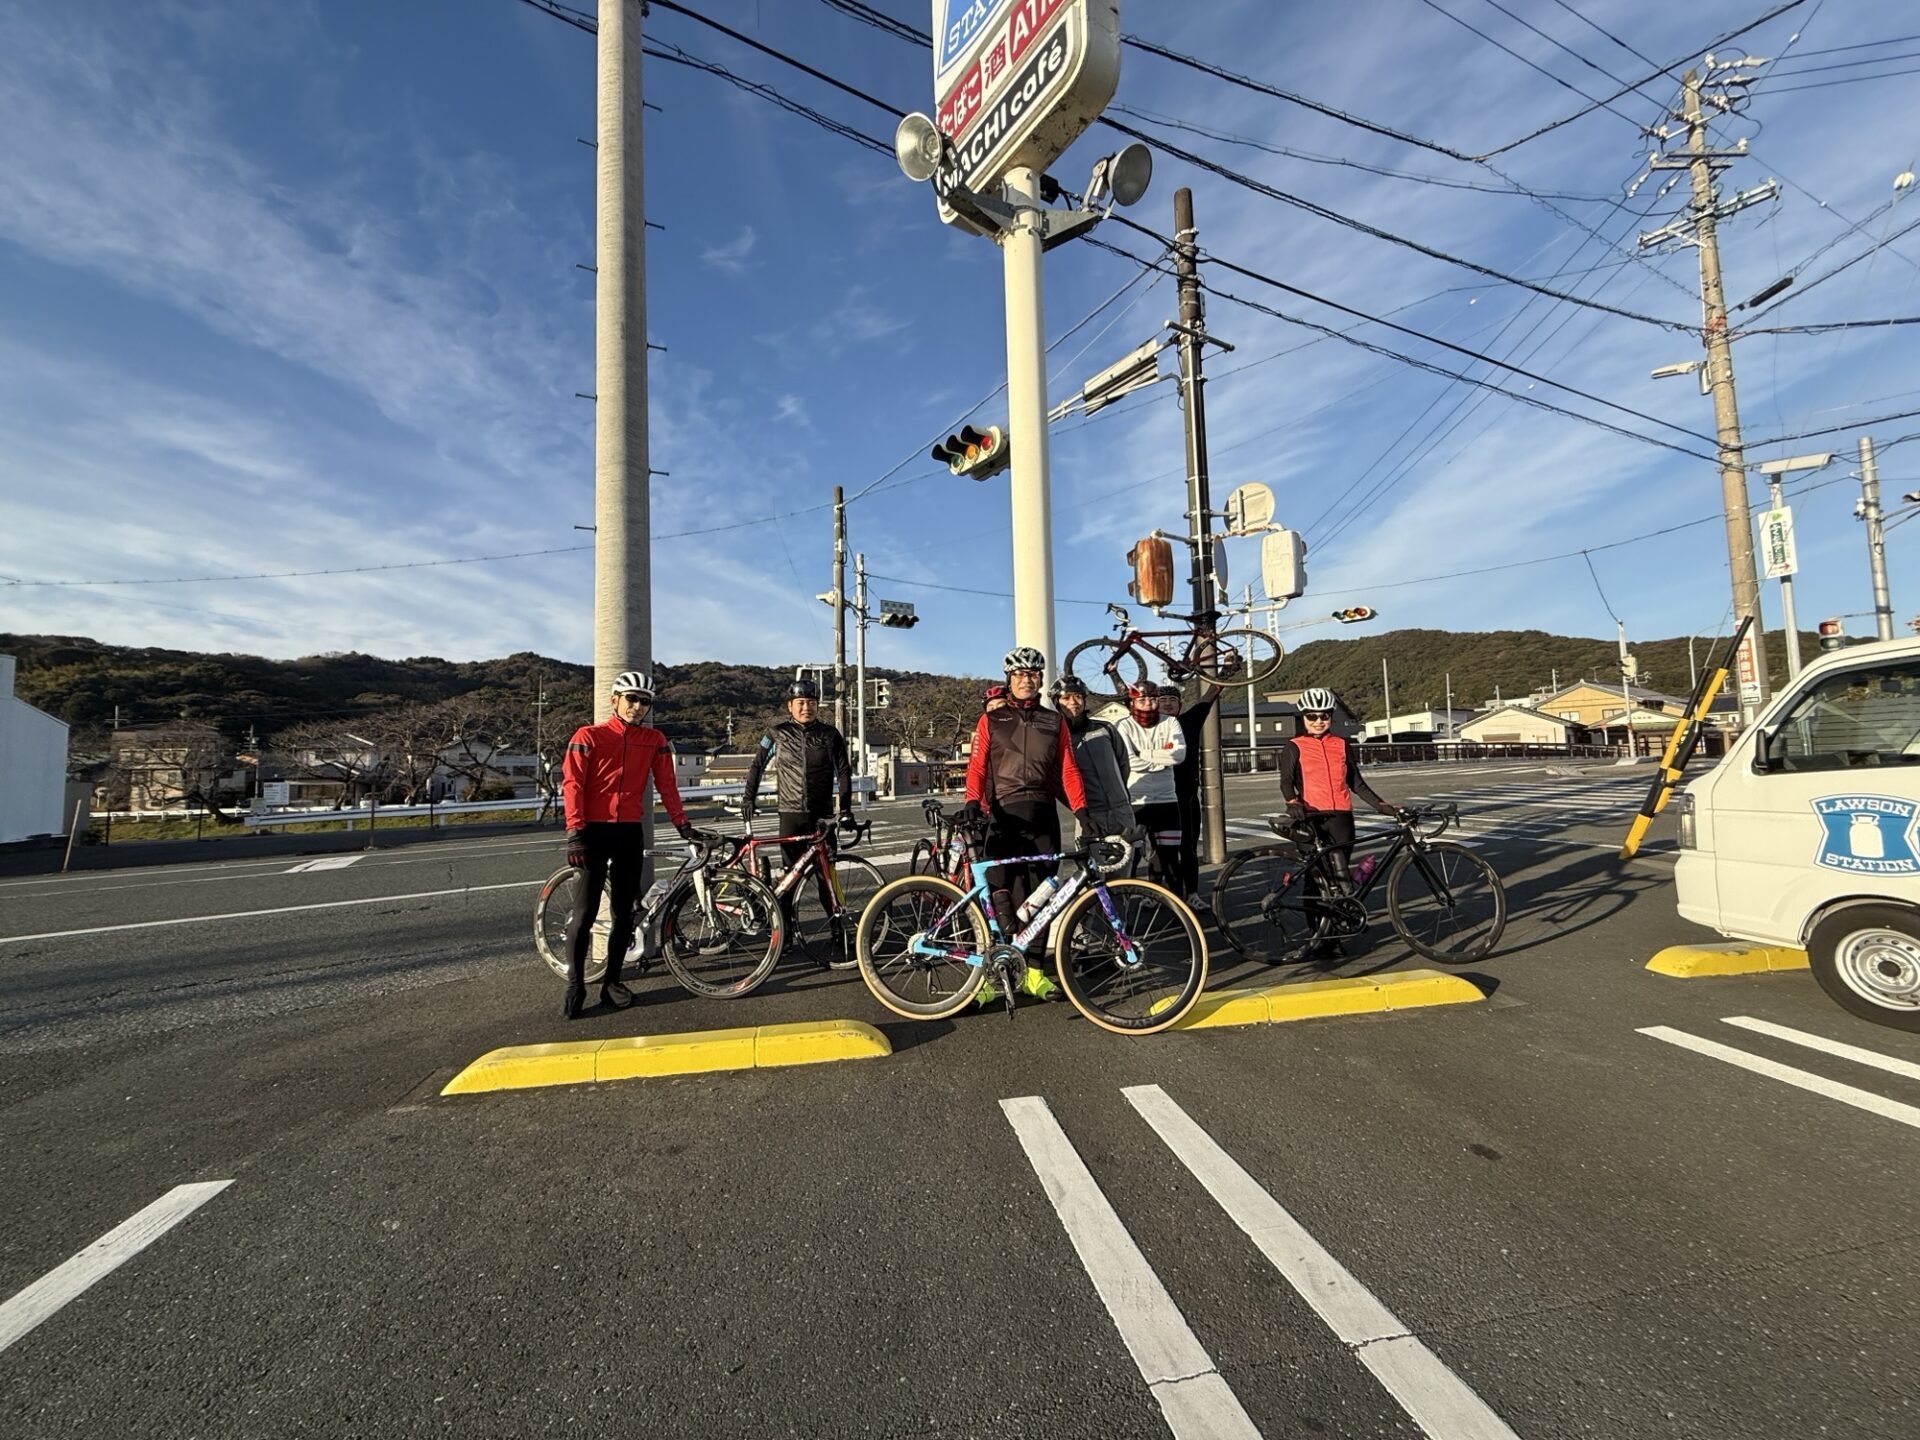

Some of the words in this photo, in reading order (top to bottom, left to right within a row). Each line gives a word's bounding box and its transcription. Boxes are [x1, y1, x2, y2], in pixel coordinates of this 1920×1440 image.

[948, 0, 994, 54] STA
[985, 33, 1006, 89] 酒
[1010, 39, 1062, 116] café
[1819, 798, 1912, 817] LAWSON
[1825, 852, 1917, 872] STATION
